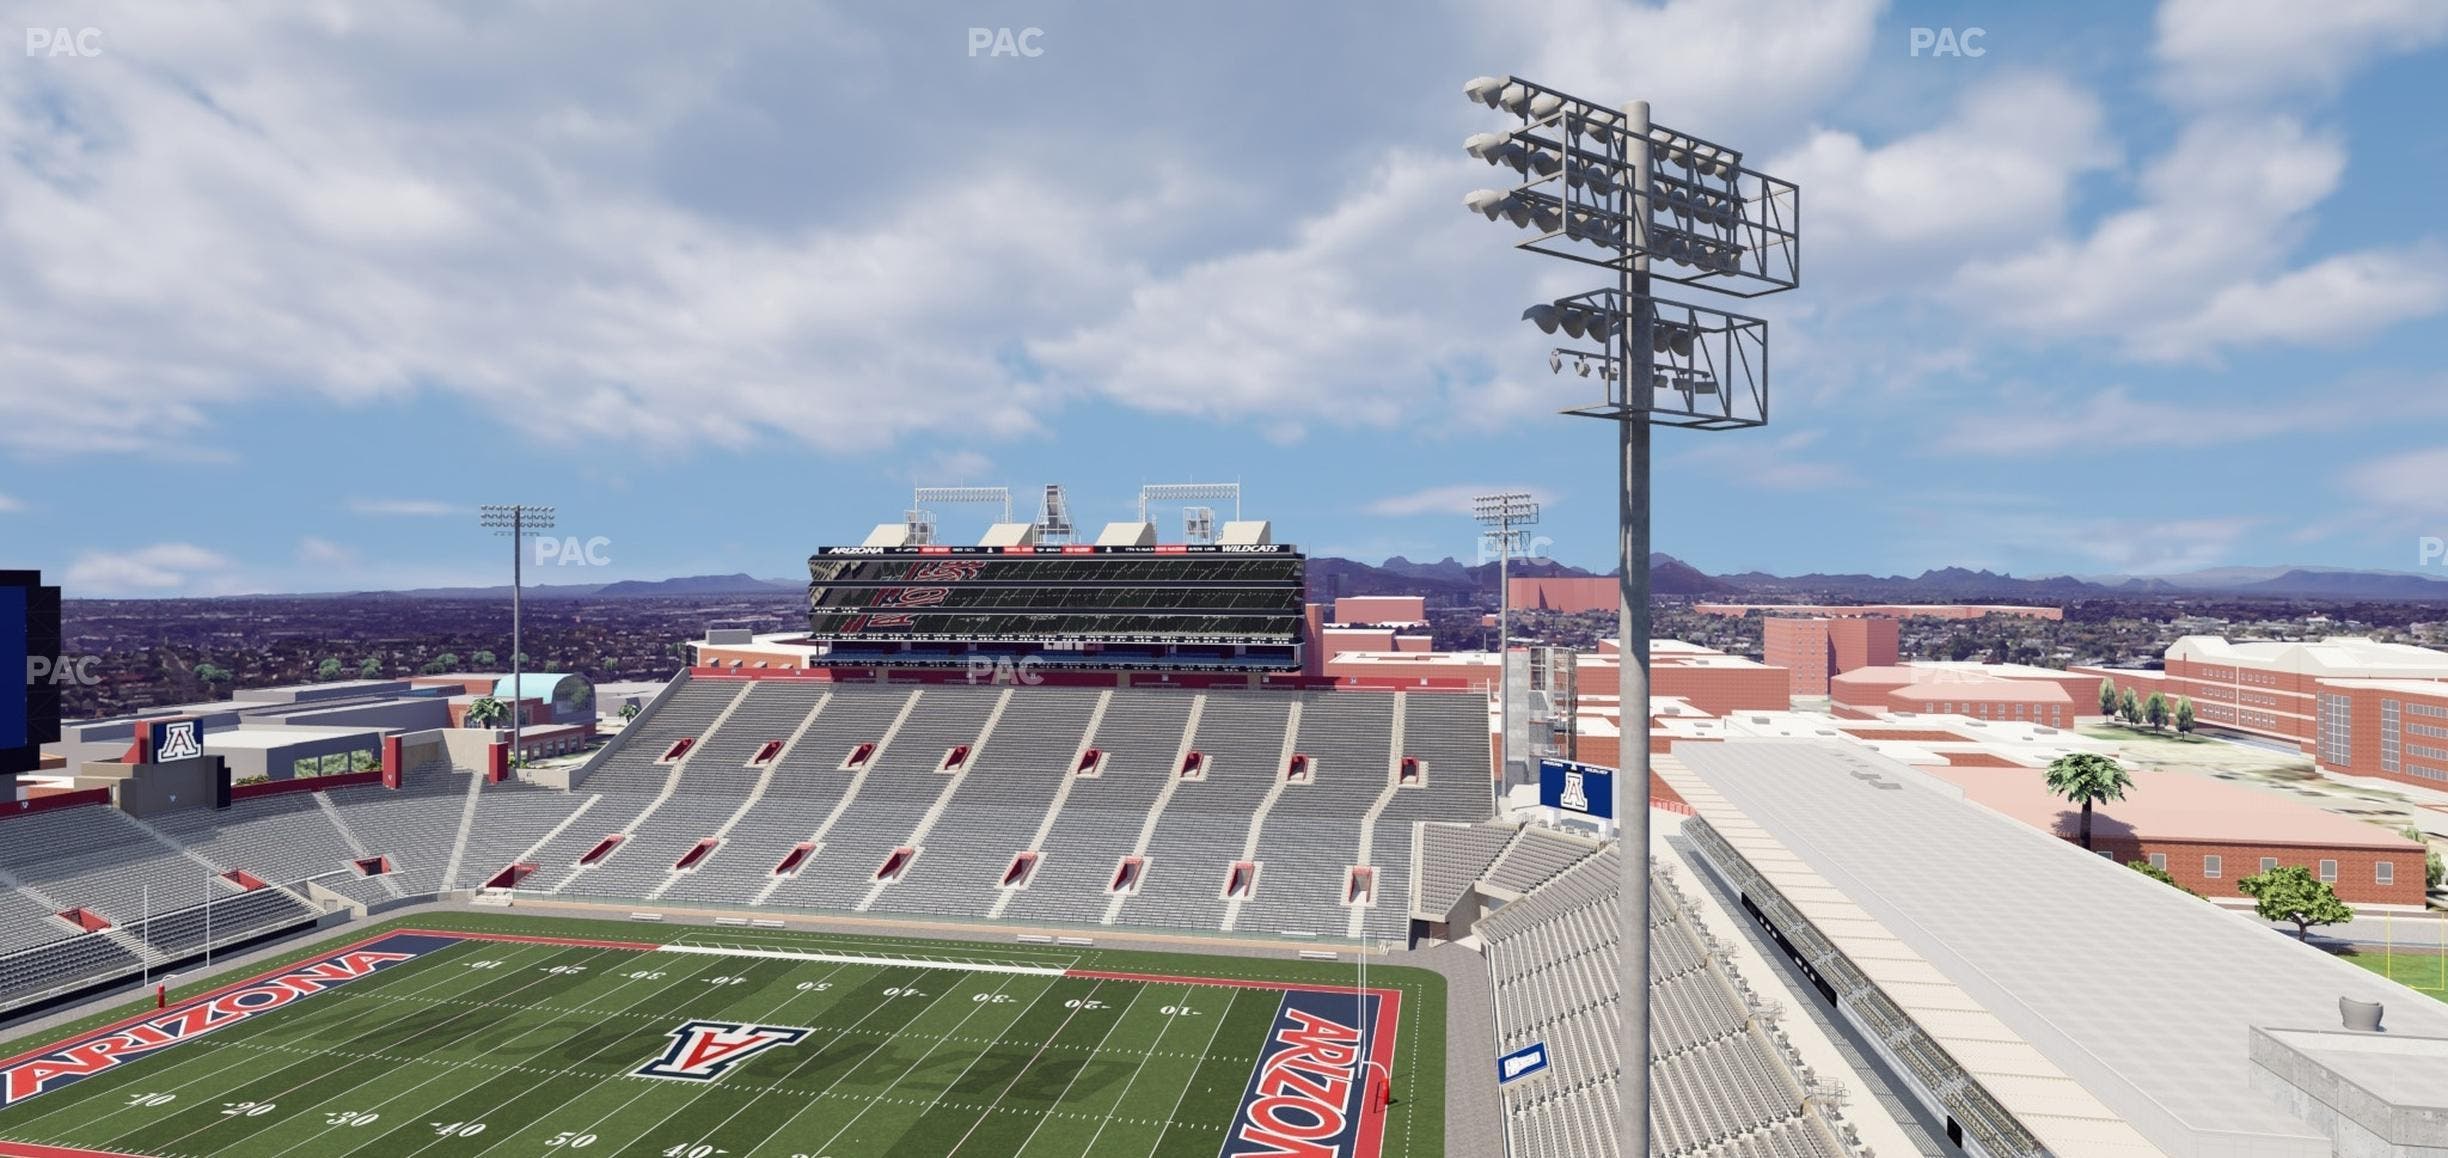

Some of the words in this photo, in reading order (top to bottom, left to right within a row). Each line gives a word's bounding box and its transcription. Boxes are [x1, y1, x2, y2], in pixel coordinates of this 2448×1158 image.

[828, 547, 884, 555] ARIZONA
[1222, 545, 1280, 553] WILDCATS
[2, 951, 417, 1103] ARIZONA
[626, 1018, 817, 1082] A
[124, 1092, 176, 1107] 10
[220, 1101, 276, 1117] 20
[326, 1111, 379, 1126] 30
[435, 1121, 486, 1137] 40
[544, 1131, 598, 1148] 50
